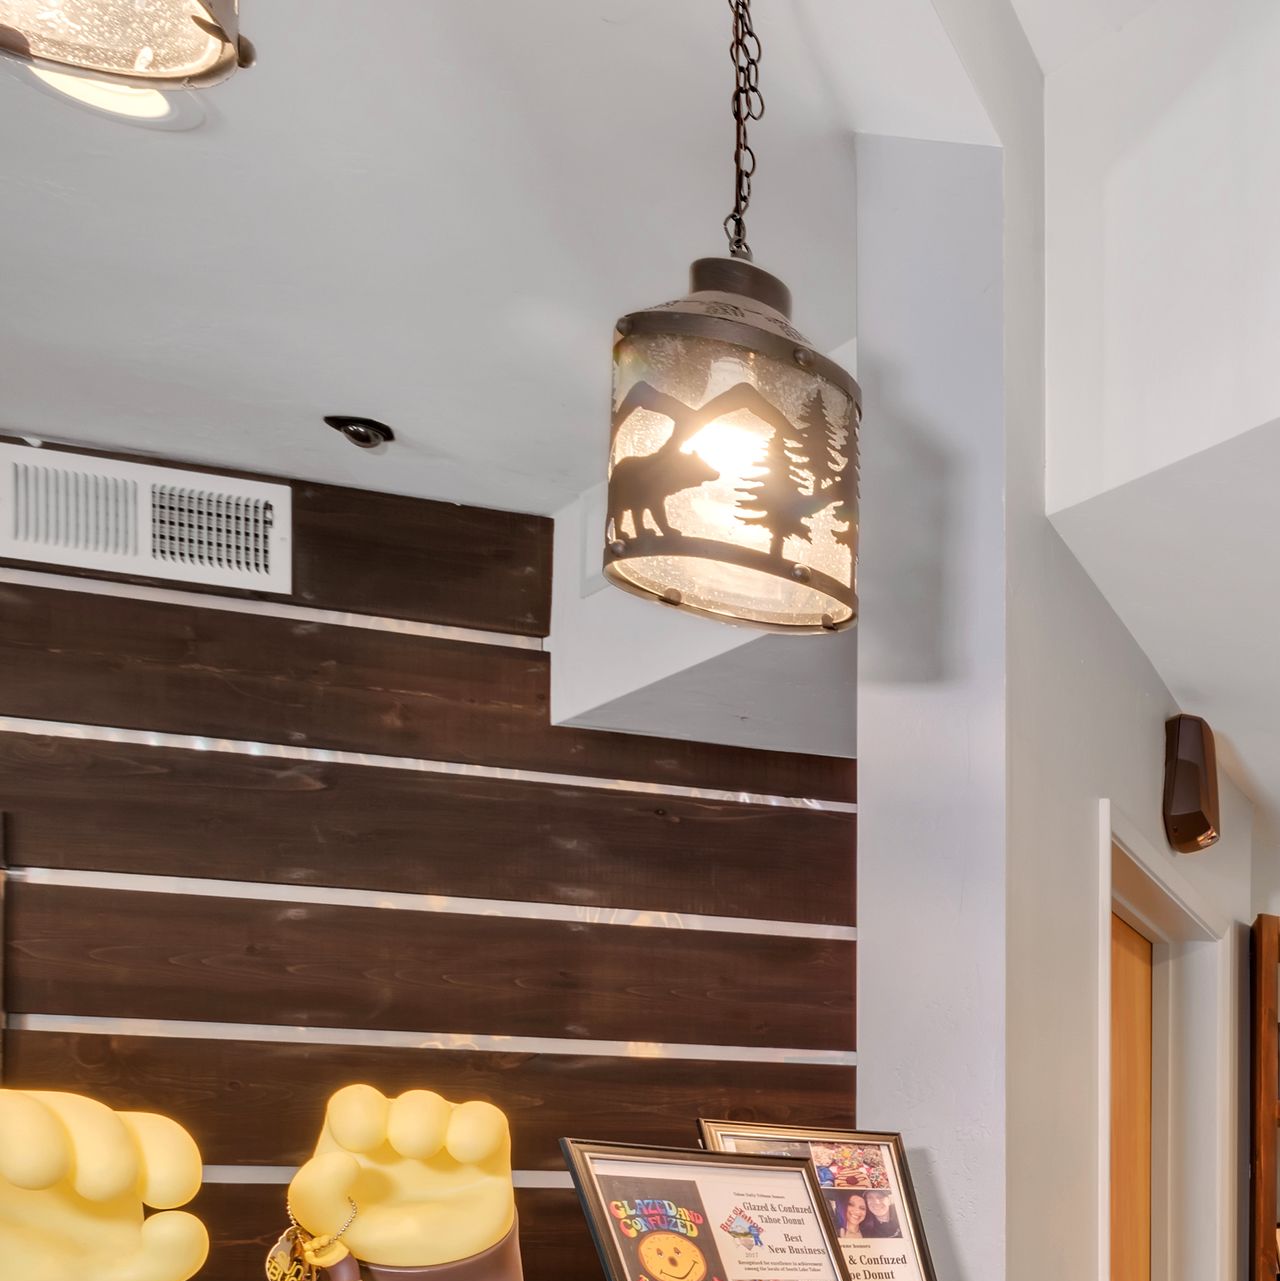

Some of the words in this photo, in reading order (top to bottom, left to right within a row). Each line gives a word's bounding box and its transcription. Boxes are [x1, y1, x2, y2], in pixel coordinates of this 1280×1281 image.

[743, 1202, 769, 1211] Glazed
[778, 1205, 812, 1214] Confuzed
[759, 1215, 781, 1223] Tahoe
[782, 1216, 805, 1225] Donut
[784, 1234, 803, 1242] Best
[768, 1245, 786, 1254] New
[788, 1246, 826, 1255] Business
[849, 1255, 857, 1265] &
[860, 1255, 907, 1265] Confuzed
[863, 1270, 895, 1280] Donut
